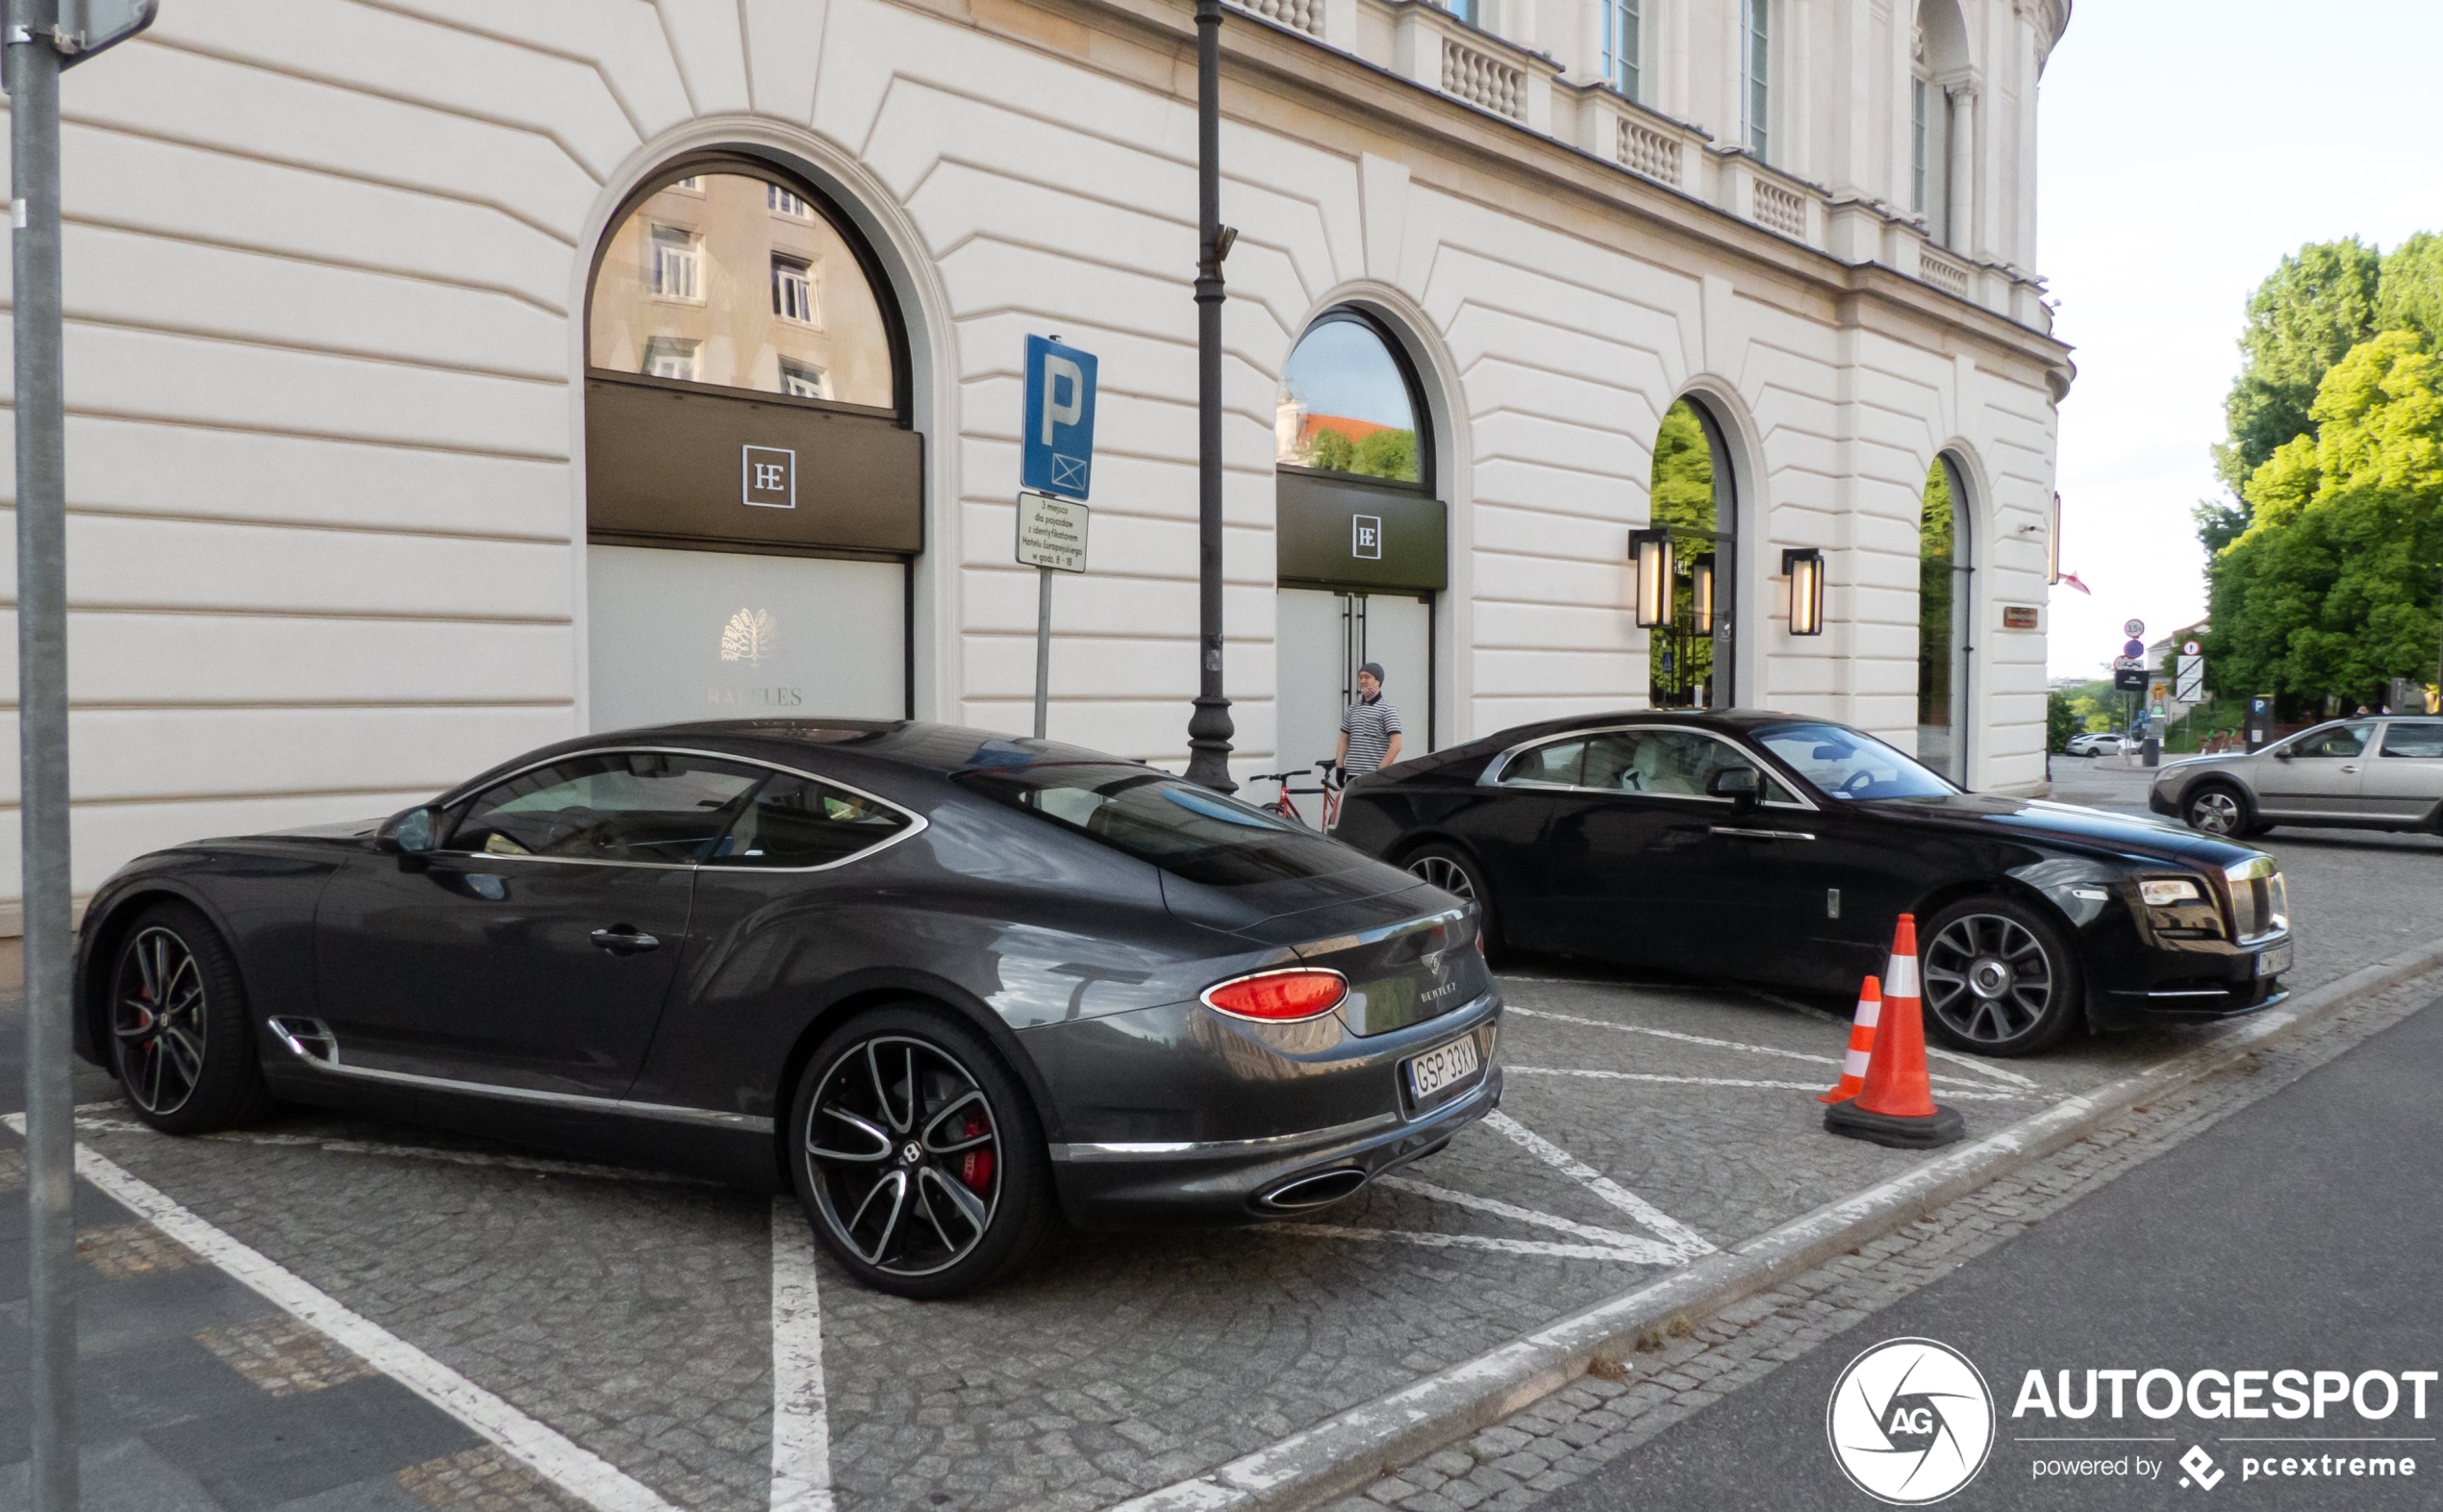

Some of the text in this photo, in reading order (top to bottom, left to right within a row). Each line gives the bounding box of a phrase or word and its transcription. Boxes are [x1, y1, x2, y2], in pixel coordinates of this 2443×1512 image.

[1042, 353, 1083, 446] P
[754, 464, 784, 491] HE
[1035, 513, 1045, 522] dla
[1042, 500, 1069, 515] 3 miejsca
[1033, 526, 1078, 542] identyfikatorem
[1359, 527, 1375, 547] HE
[1022, 536, 1083, 558] Hotelu Europejskiego
[1055, 555, 1060, 565] 8
[1067, 558, 1072, 567] 18
[2254, 700, 2264, 714] P
[1421, 982, 1456, 1002] BENTLEY
[1416, 1038, 1477, 1093] GSP 33XX
